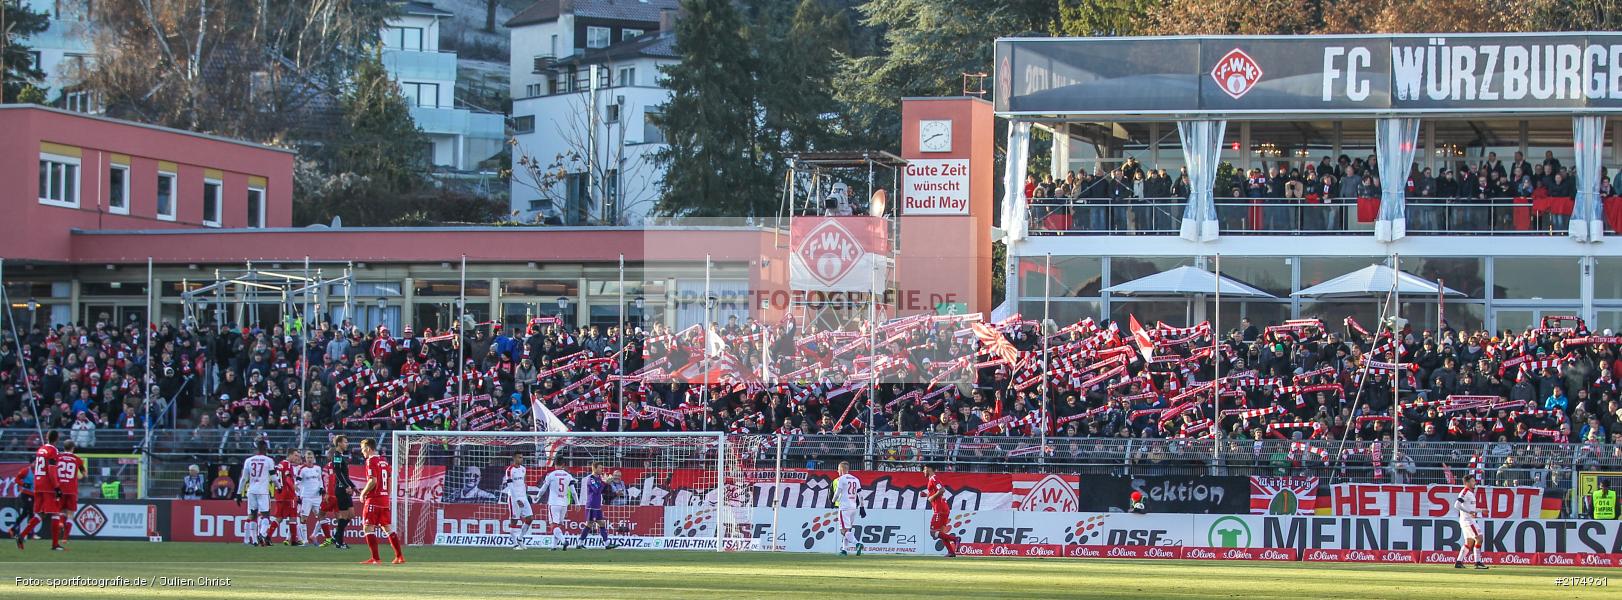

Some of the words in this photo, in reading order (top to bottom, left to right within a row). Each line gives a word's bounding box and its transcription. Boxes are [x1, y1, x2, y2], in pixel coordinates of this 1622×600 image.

[1323, 46, 1371, 101] FC
[906, 164, 938, 176] Gute
[941, 163, 967, 176] Zeit
[914, 180, 960, 191] wünscht
[906, 196, 936, 208] Rudi
[939, 196, 967, 211] May
[57, 461, 76, 479] 29
[250, 462, 265, 478] 37
[381, 469, 388, 490] 8
[558, 478, 565, 490] 5
[1334, 484, 1541, 519] HETTSADT
[989, 545, 1018, 555] s.Oliver
[1025, 545, 1055, 556] s.Oliver
[1070, 547, 1100, 557] s.Oliver
[1107, 547, 1137, 557] s.Oliver
[1144, 548, 1174, 558] s.Oliver
[1187, 549, 1217, 559] s.Oliver
[1223, 550, 1252, 559] s.Oliver
[1259, 550, 1289, 560] s.Oliver
[1308, 551, 1338, 560] s.Oliver
[1345, 551, 1375, 561] s.Oliver
[1382, 551, 1412, 561] s.Oliver
[1426, 552, 1455, 563] s.Oliver
[1500, 553, 1531, 564] s.Oliver
[1543, 555, 1574, 565] s.Oliver
[1581, 555, 1611, 565] s.Oliver
